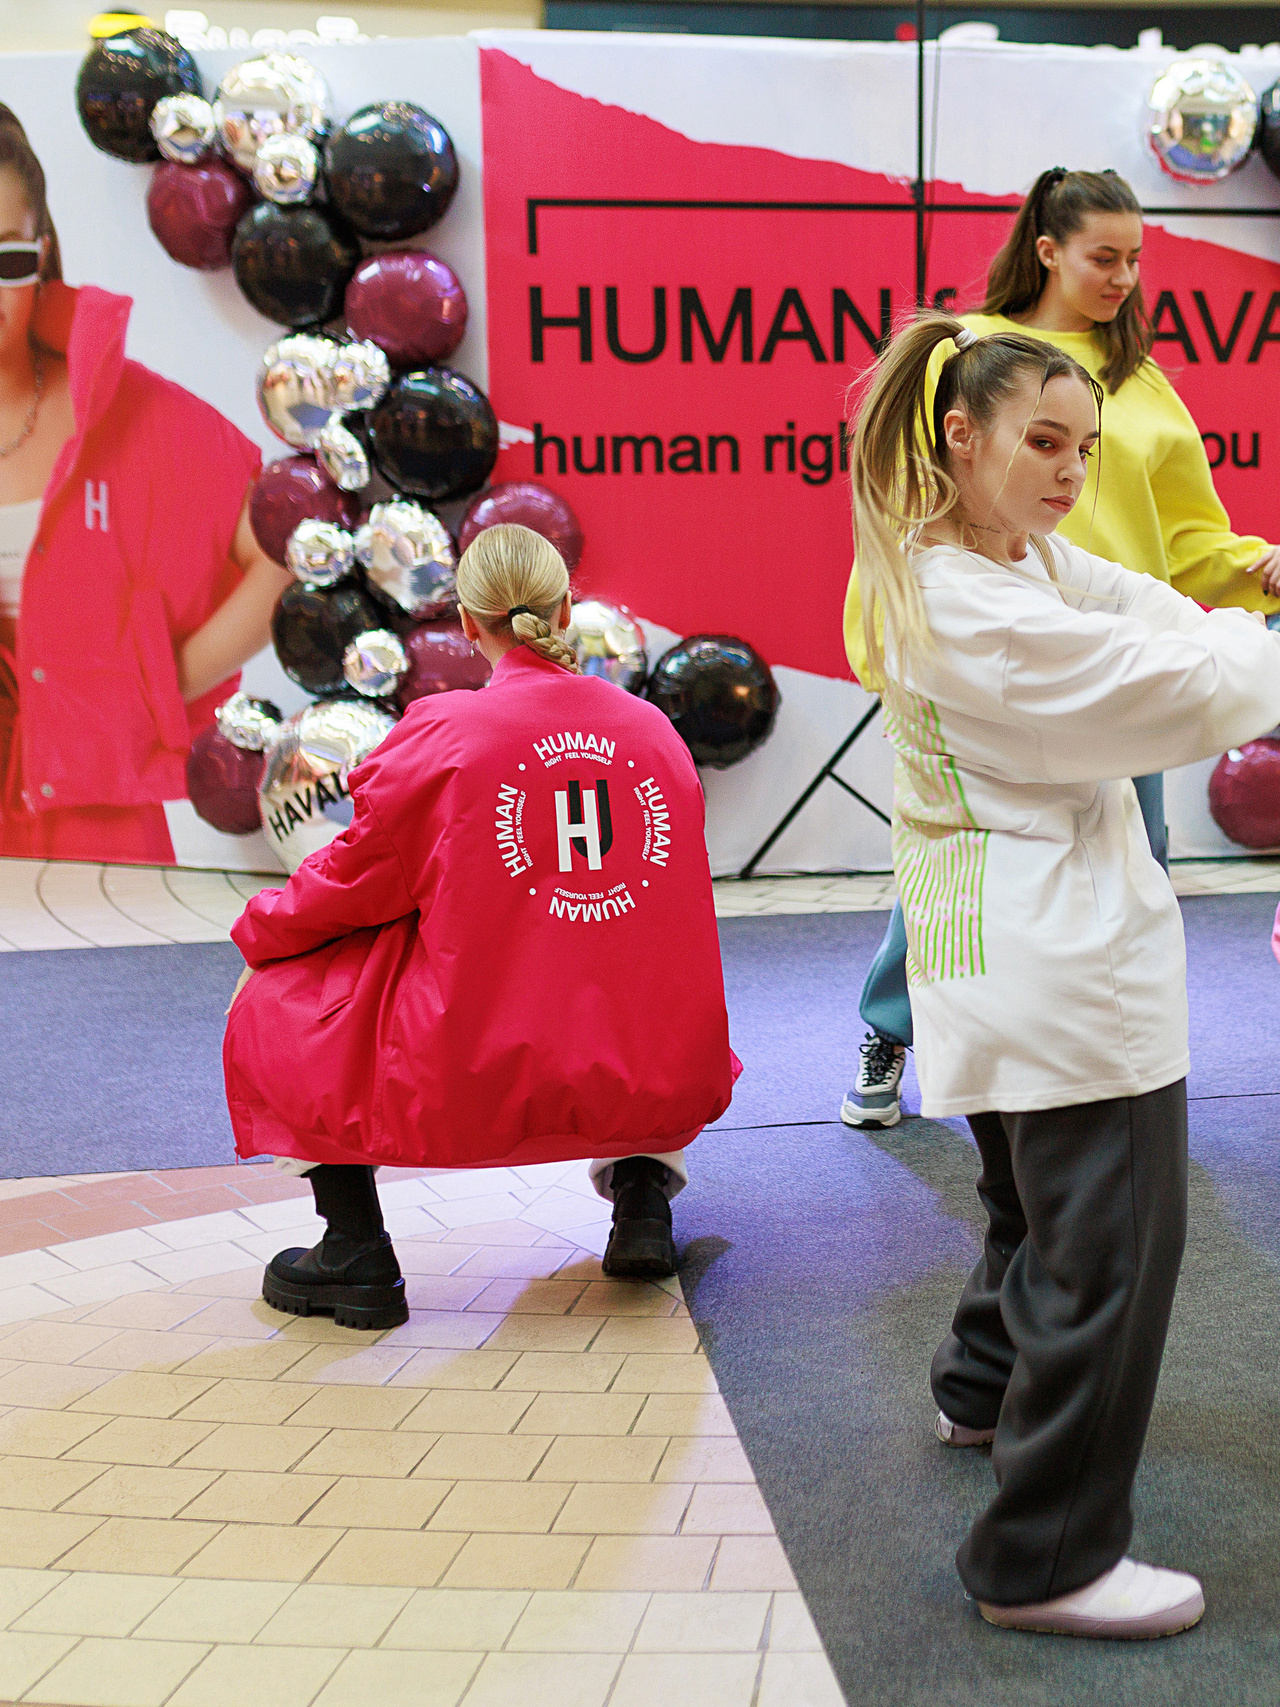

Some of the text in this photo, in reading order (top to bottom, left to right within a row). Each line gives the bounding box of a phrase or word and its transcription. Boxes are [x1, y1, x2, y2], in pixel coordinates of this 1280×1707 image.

[529, 286, 891, 364] HUMAN
[533, 423, 740, 475] human
[1200, 431, 1260, 469] ou
[85, 479, 108, 532] H
[532, 731, 616, 761] HUMAN
[544, 752, 613, 768] RIGHT FEEL YOURSELF
[268, 771, 350, 842] HAVAL
[495, 783, 527, 878] HUMAN
[515, 790, 534, 867] RIGHT FEEL YOURSELF
[633, 786, 652, 861] RIGHT FEEL YOURSELF
[639, 777, 671, 867] HUMAN
[548, 890, 636, 923] HUMAN
[553, 882, 627, 900] RIGHT FEEL YOURSELF
